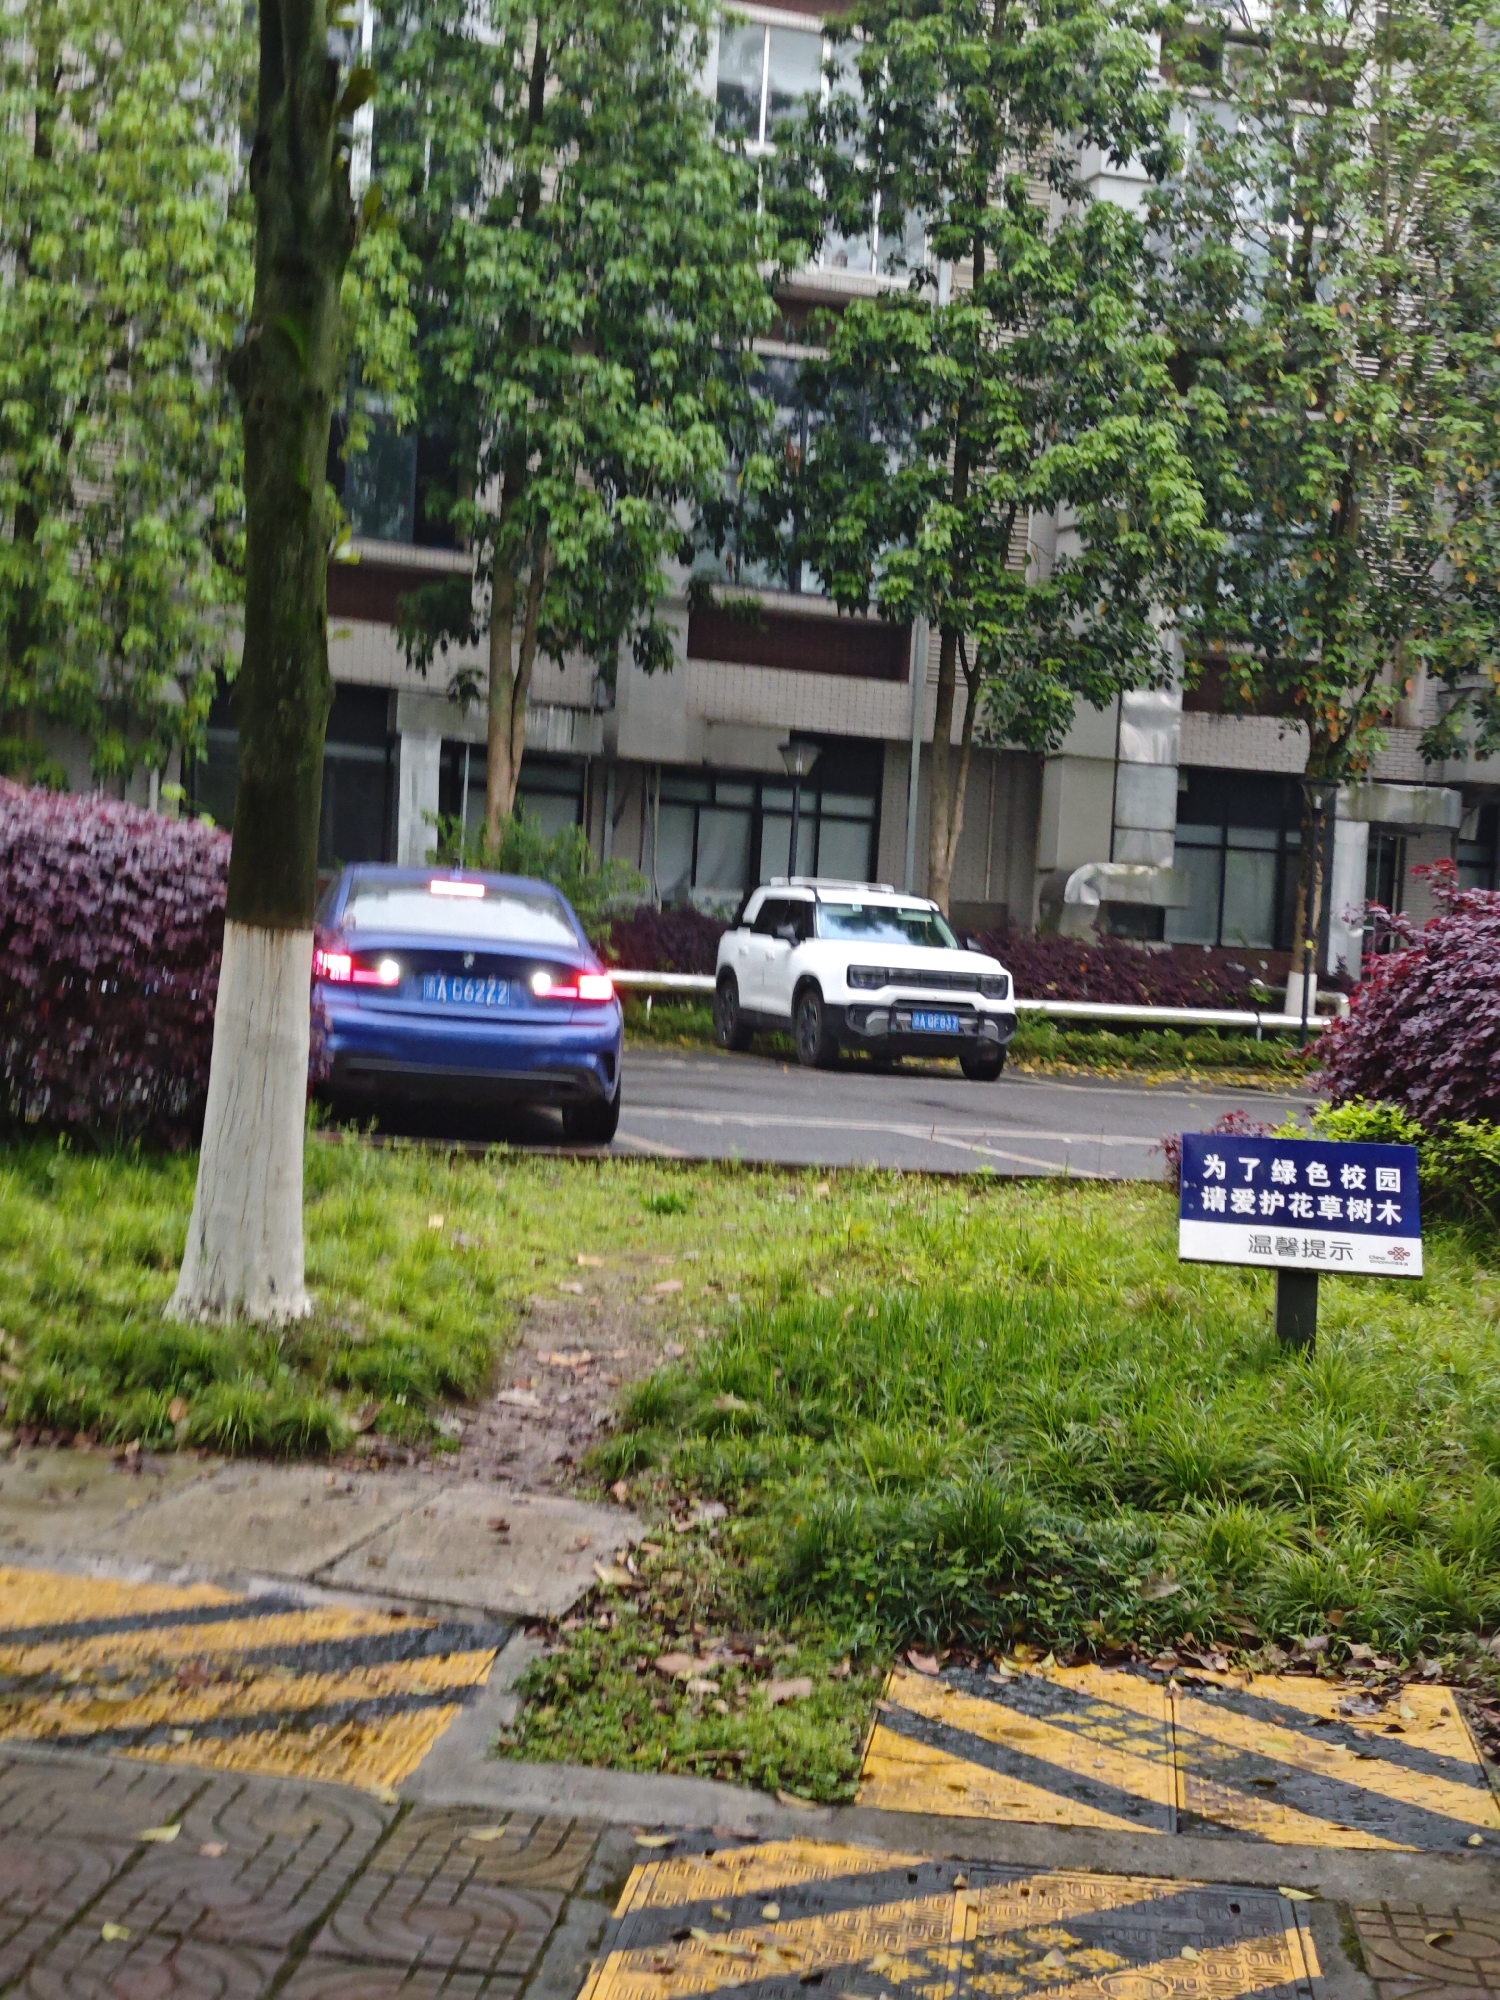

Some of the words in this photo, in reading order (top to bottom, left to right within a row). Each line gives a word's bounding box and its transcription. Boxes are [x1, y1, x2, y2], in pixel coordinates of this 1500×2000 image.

[1202, 1155, 1401, 1193] 为了绿色校园
[1201, 1186, 1402, 1225] 请爱护花草树木
[1248, 1234, 1353, 1261] 温馨提示
